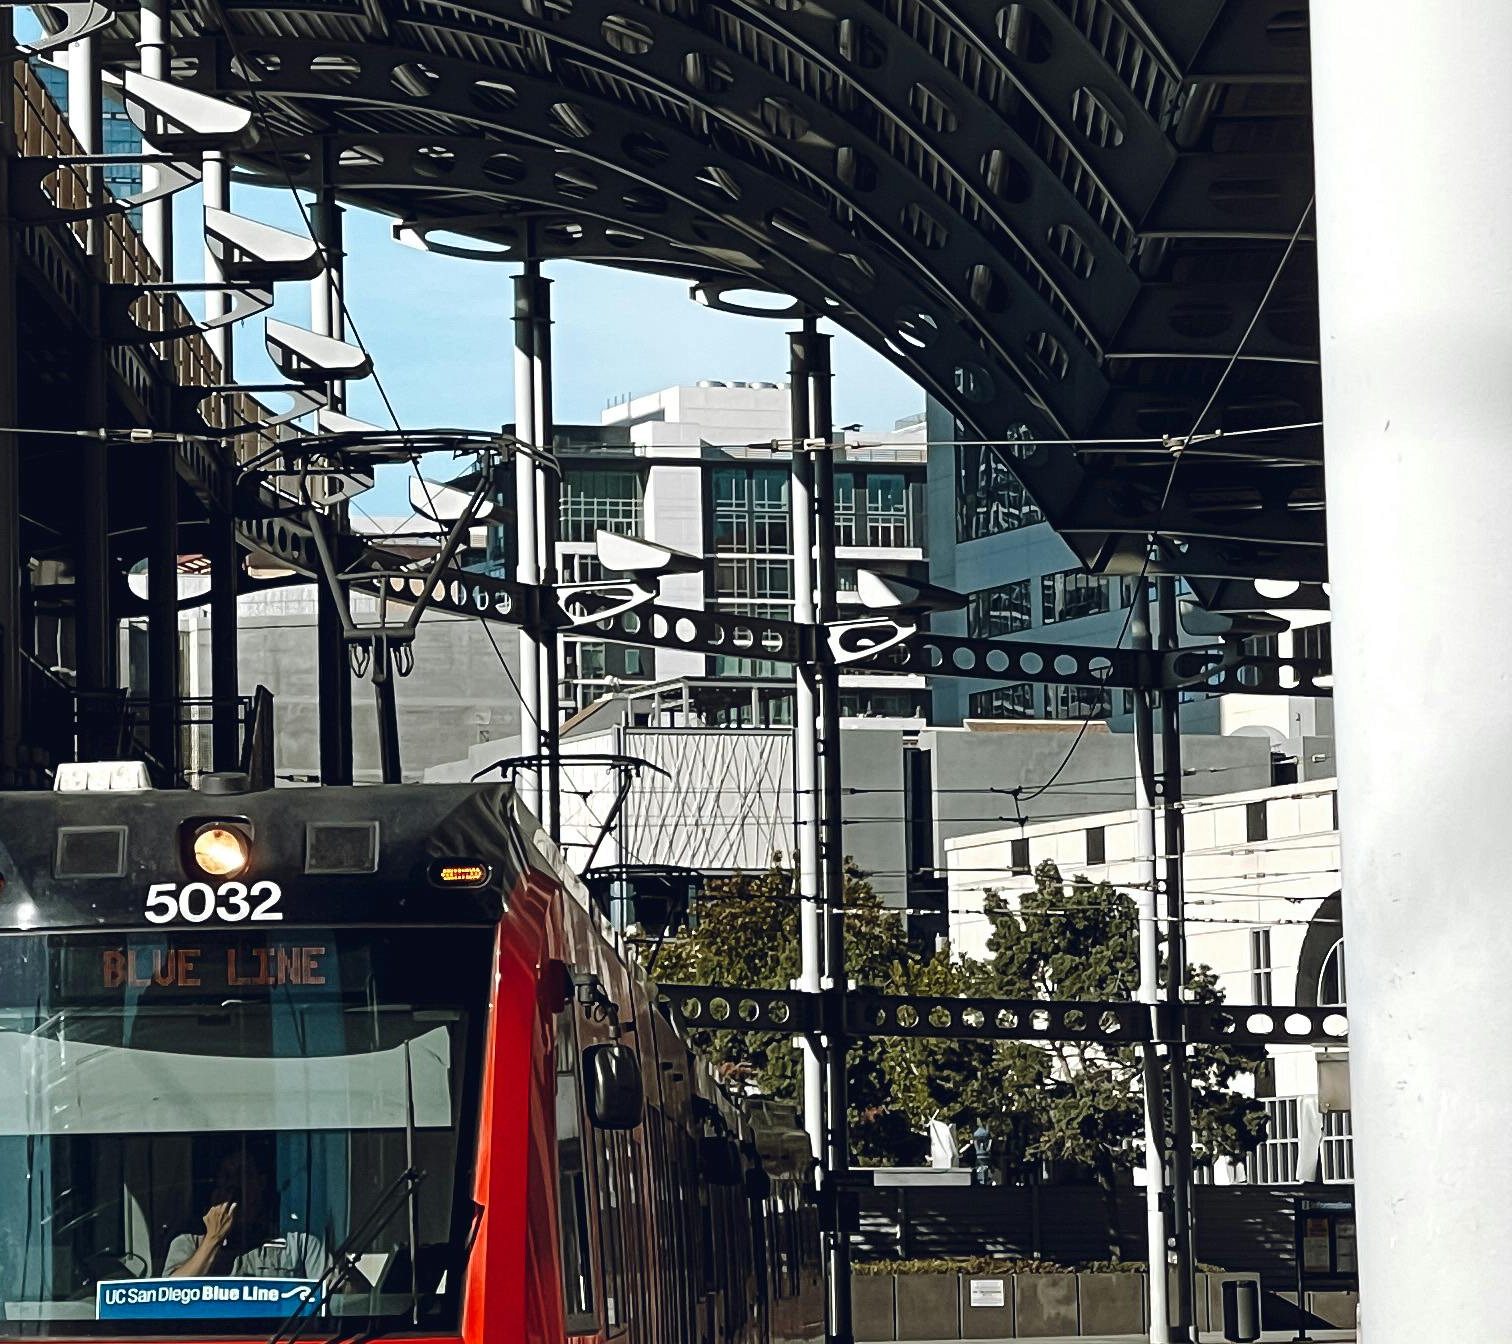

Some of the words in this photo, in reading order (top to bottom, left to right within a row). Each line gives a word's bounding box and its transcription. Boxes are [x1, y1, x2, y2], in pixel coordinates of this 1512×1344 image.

[144, 880, 284, 924] 5032
[103, 948, 201, 988] BLUE
[225, 947, 326, 986] LINE
[105, 1289, 126, 1305] UC
[128, 1288, 157, 1303] San
[158, 1286, 201, 1305] Diego
[202, 1286, 239, 1301] Blue
[242, 1286, 279, 1301] Line
